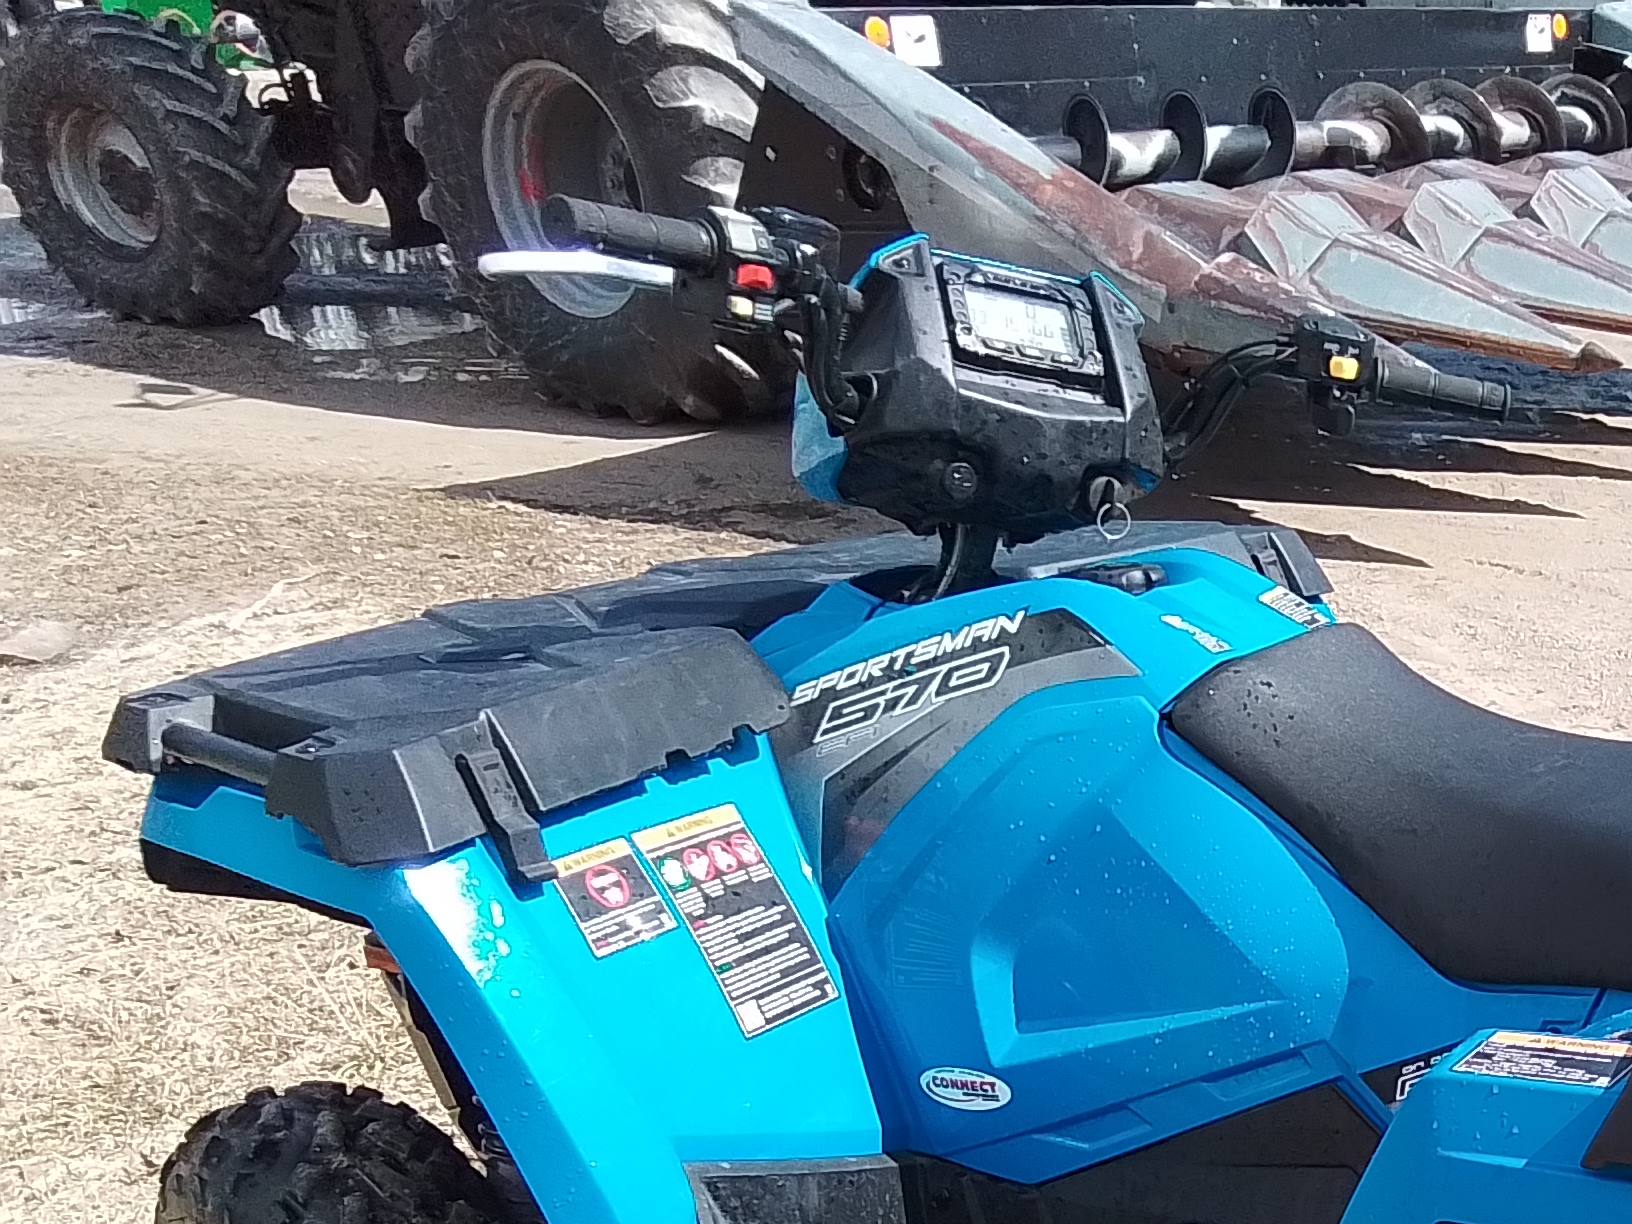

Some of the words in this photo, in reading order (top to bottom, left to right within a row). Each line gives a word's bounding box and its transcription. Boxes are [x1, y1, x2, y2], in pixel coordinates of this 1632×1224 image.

[790, 610, 1026, 707] SPORTSMAN
[813, 645, 1010, 743] 570
[1547, 1038, 1611, 1051] WARNING
[931, 1075, 997, 1094] CONNECT
